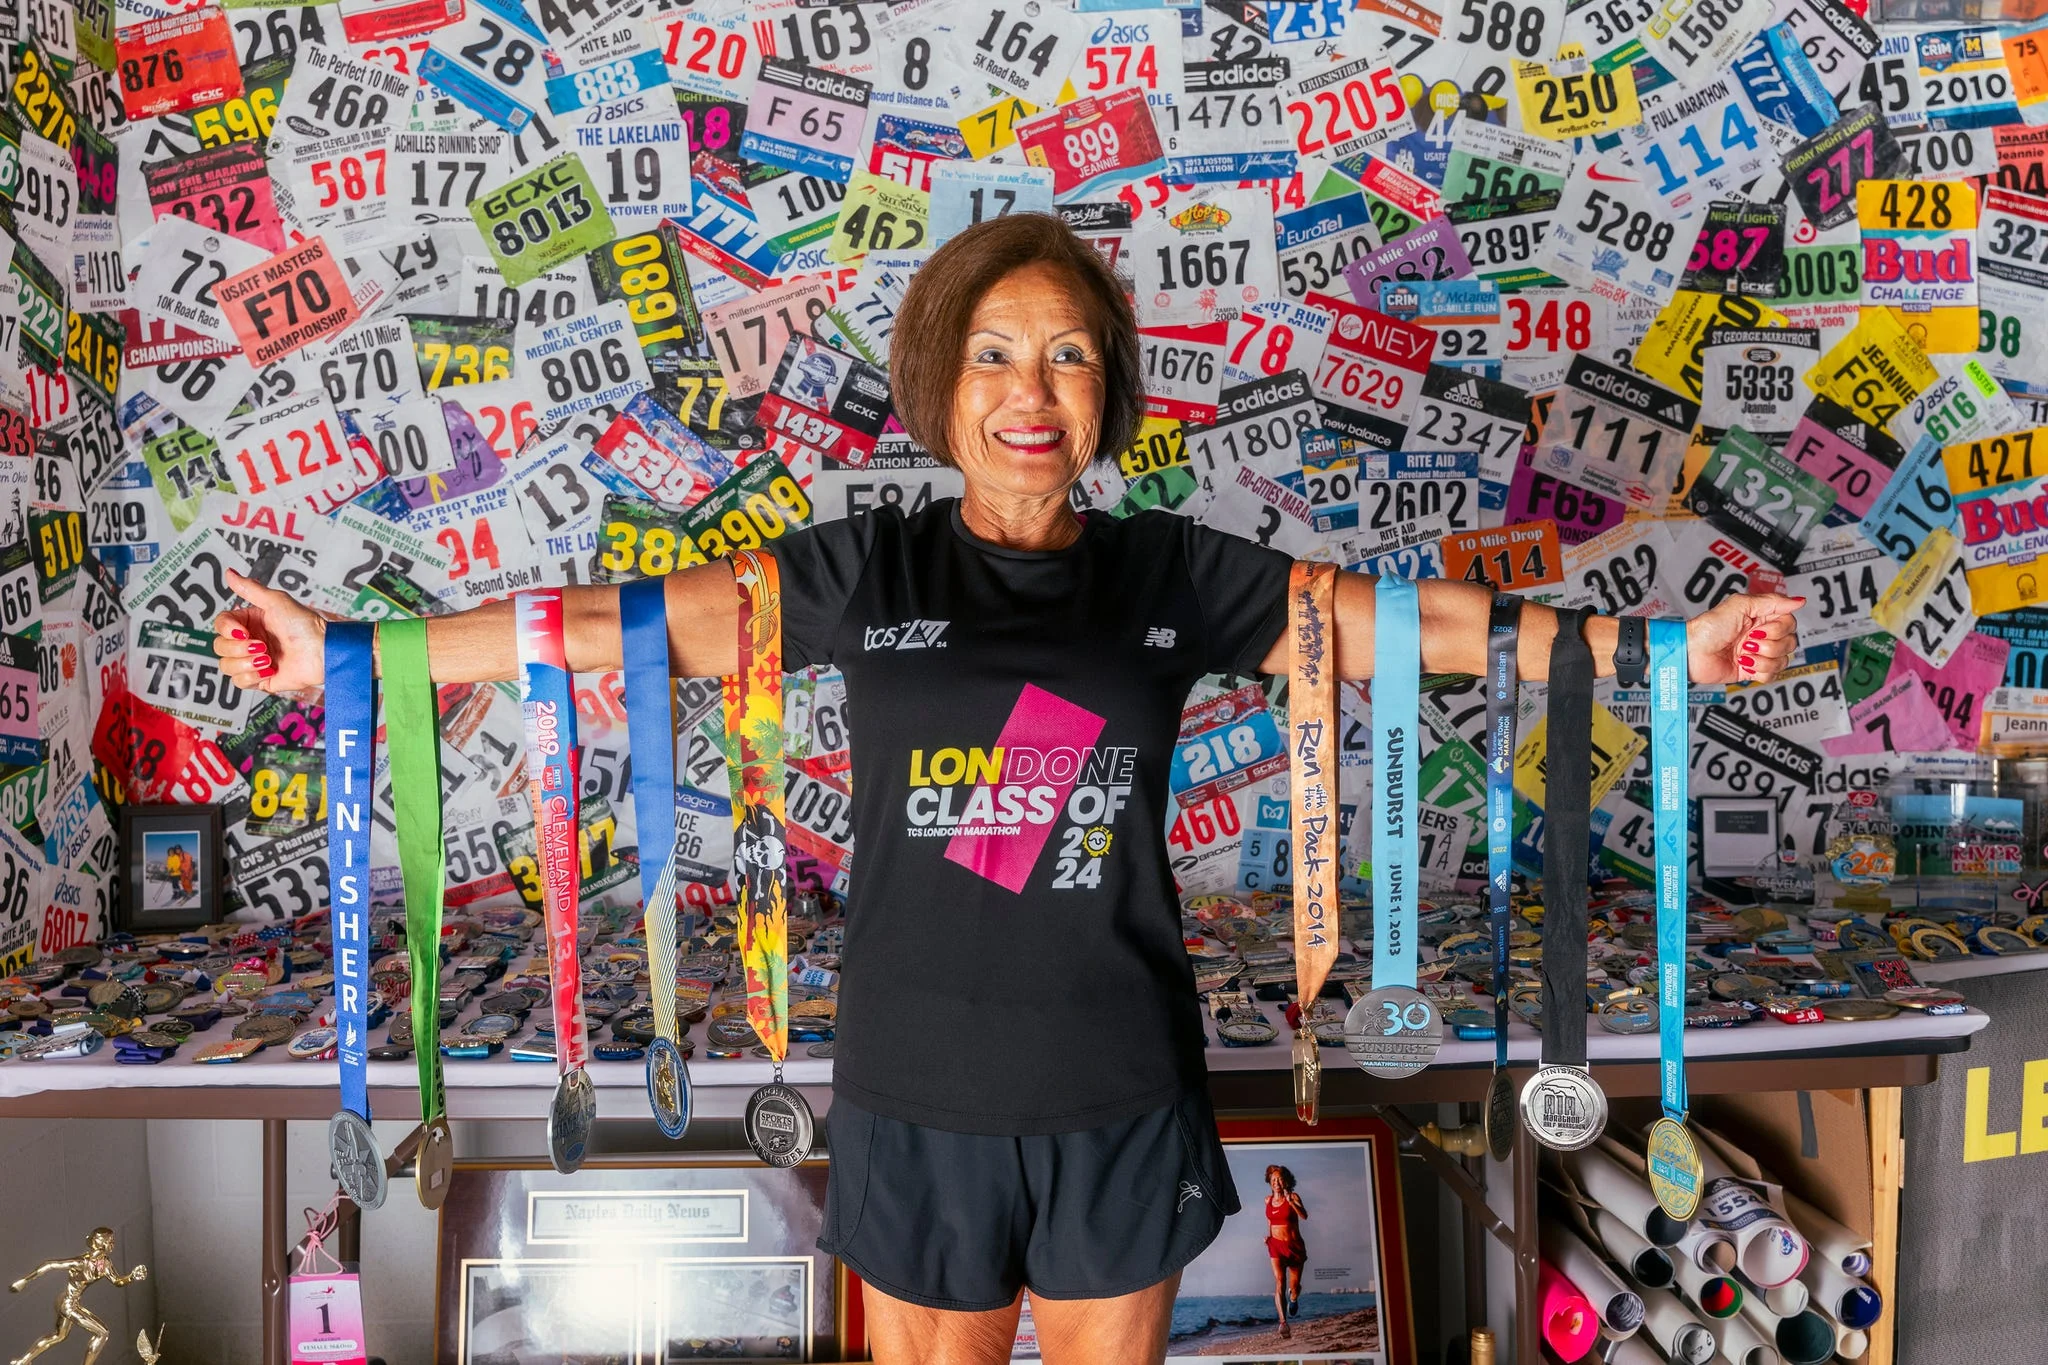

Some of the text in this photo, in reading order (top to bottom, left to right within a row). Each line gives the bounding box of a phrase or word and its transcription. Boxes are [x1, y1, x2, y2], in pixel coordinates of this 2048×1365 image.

[613, 28, 632, 44] AID
[662, 21, 748, 79] 120
[976, 9, 1059, 77] 164
[1458, 0, 1545, 58] 588
[1823, 8, 1876, 56] adidas
[1921, 43, 1952, 56] CRIM
[122, 48, 184, 93] 876
[307, 46, 409, 98] The Perfect 10 Miler
[461, 18, 535, 86] 28
[579, 43, 641, 66] Cleveland Marathon
[904, 37, 931, 90] 8
[973, 54, 1029, 90] 5K Road Race
[1086, 45, 1158, 91] 574
[1209, 62, 1285, 86] adidas
[192, 87, 224, 101] GCXC
[308, 76, 388, 129] 468
[574, 60, 640, 108] 883
[1534, 71, 1618, 125] 250
[1651, 80, 1730, 132] FULL MARATHON
[1925, 73, 2007, 106] 2010
[1287, 66, 1406, 156] 2205
[577, 122, 681, 146] THE LAKELAND
[1063, 122, 1120, 169] 899
[1644, 102, 1760, 196] 114
[311, 148, 386, 207] 587
[410, 160, 488, 207] 177
[607, 147, 662, 203] 19
[1078, 155, 1120, 179] JEANNIE
[1807, 129, 1875, 216] 277
[483, 162, 575, 219] GCXC
[662, 203, 688, 215] RUN
[1880, 183, 1952, 230] 428
[493, 183, 592, 257] 8013
[1576, 189, 1675, 262] 5288
[1711, 212, 1778, 225] NIGHT LIGHTS
[1157, 239, 1250, 290] 1667
[1861, 237, 1972, 284] Bud
[243, 269, 332, 340] F70
[1386, 294, 1419, 307] CRIM
[1431, 303, 1497, 314] 10-MILE RUN
[1869, 284, 1965, 302] CHALLENGE
[255, 308, 348, 362] CHAMPIONSHIP
[526, 320, 624, 361] MEDICAL CENTER
[543, 314, 599, 342] MT. SINAI
[1229, 312, 1294, 376] 78
[1441, 329, 1488, 356] 92
[1507, 299, 1592, 352] 348
[1711, 328, 1812, 346] ST GEORGE MARATHON
[67, 312, 120, 395] 2413
[320, 347, 398, 404] 670
[541, 338, 632, 402] 806
[1147, 345, 1214, 385] 1676
[1862, 343, 1917, 405] JEANNIE
[1231, 380, 1304, 414] adidas
[1444, 390, 1483, 409] adidas
[1580, 367, 1653, 407] adidas
[1725, 365, 1795, 402] 5333
[1832, 355, 1902, 430] F64
[774, 405, 843, 450] 1437
[844, 400, 879, 421] GCXC
[1741, 400, 1777, 416] Jeannie
[1924, 391, 1977, 442] 616
[1324, 418, 1392, 447] new balance
[1416, 404, 1518, 460] 2347
[1570, 403, 1664, 477] 111
[33, 456, 62, 503] 46
[236, 419, 342, 496] 1121
[609, 431, 695, 506] 339
[1407, 455, 1456, 468] RITE AID
[1968, 436, 2034, 488] 427
[406, 488, 508, 525] PATRIOT RUN
[524, 463, 590, 532] 13
[1370, 481, 1467, 530] 2602
[40, 510, 84, 578] 510
[90, 501, 147, 545] 2399
[1380, 522, 1416, 541] RITE AID
[1458, 528, 1544, 552] 10 Mile Drop
[465, 573, 503, 597] Second
[506, 569, 530, 588] Sole
[1464, 544, 1547, 586] 414
[1811, 565, 1878, 619] 314
[1905, 557, 1968, 656] 217
[864, 626, 898, 651] tcs
[1497, 651, 1507, 688] Sanlam
[537, 699, 560, 756] 2019
[1297, 718, 1324, 779] Run
[1865, 713, 1896, 751] 7
[1182, 725, 1262, 784] 218
[1252, 760, 1281, 776] GCXC
[1745, 731, 1811, 774] adidas
[545, 770, 553, 787] AID
[554, 768, 562, 786] RITE
[1315, 782, 1326, 811] with
[1386, 726, 1406, 838] SUNBURST
[906, 785, 1132, 826] CLASS OF
[1168, 794, 1241, 853] 460
[549, 794, 571, 913] CLEVELAND
[907, 826, 1021, 837] TCS LONDON MARATHON
[1198, 840, 1243, 861] BROOKS
[1301, 813, 1330, 878] Pack
[238, 844, 317, 881] Cleveland Marathon
[240, 851, 264, 870] CVS
[336, 729, 362, 1014] FINISHER
[544, 824, 557, 889] MARATHON
[1051, 857, 1102, 889] 24
[1389, 862, 1403, 903] JUNE
[1303, 882, 1328, 950] 2014
[1389, 924, 1402, 957] 2013
[1383, 1002, 1430, 1035] 30
[1358, 1044, 1427, 1053] SUNBURST
[1540, 1067, 1588, 1081] FINISHER
[761, 1112, 792, 1125] SPORTS
[564, 1202, 712, 1224] Naples Daily News
[316, 1303, 335, 1334] 1
